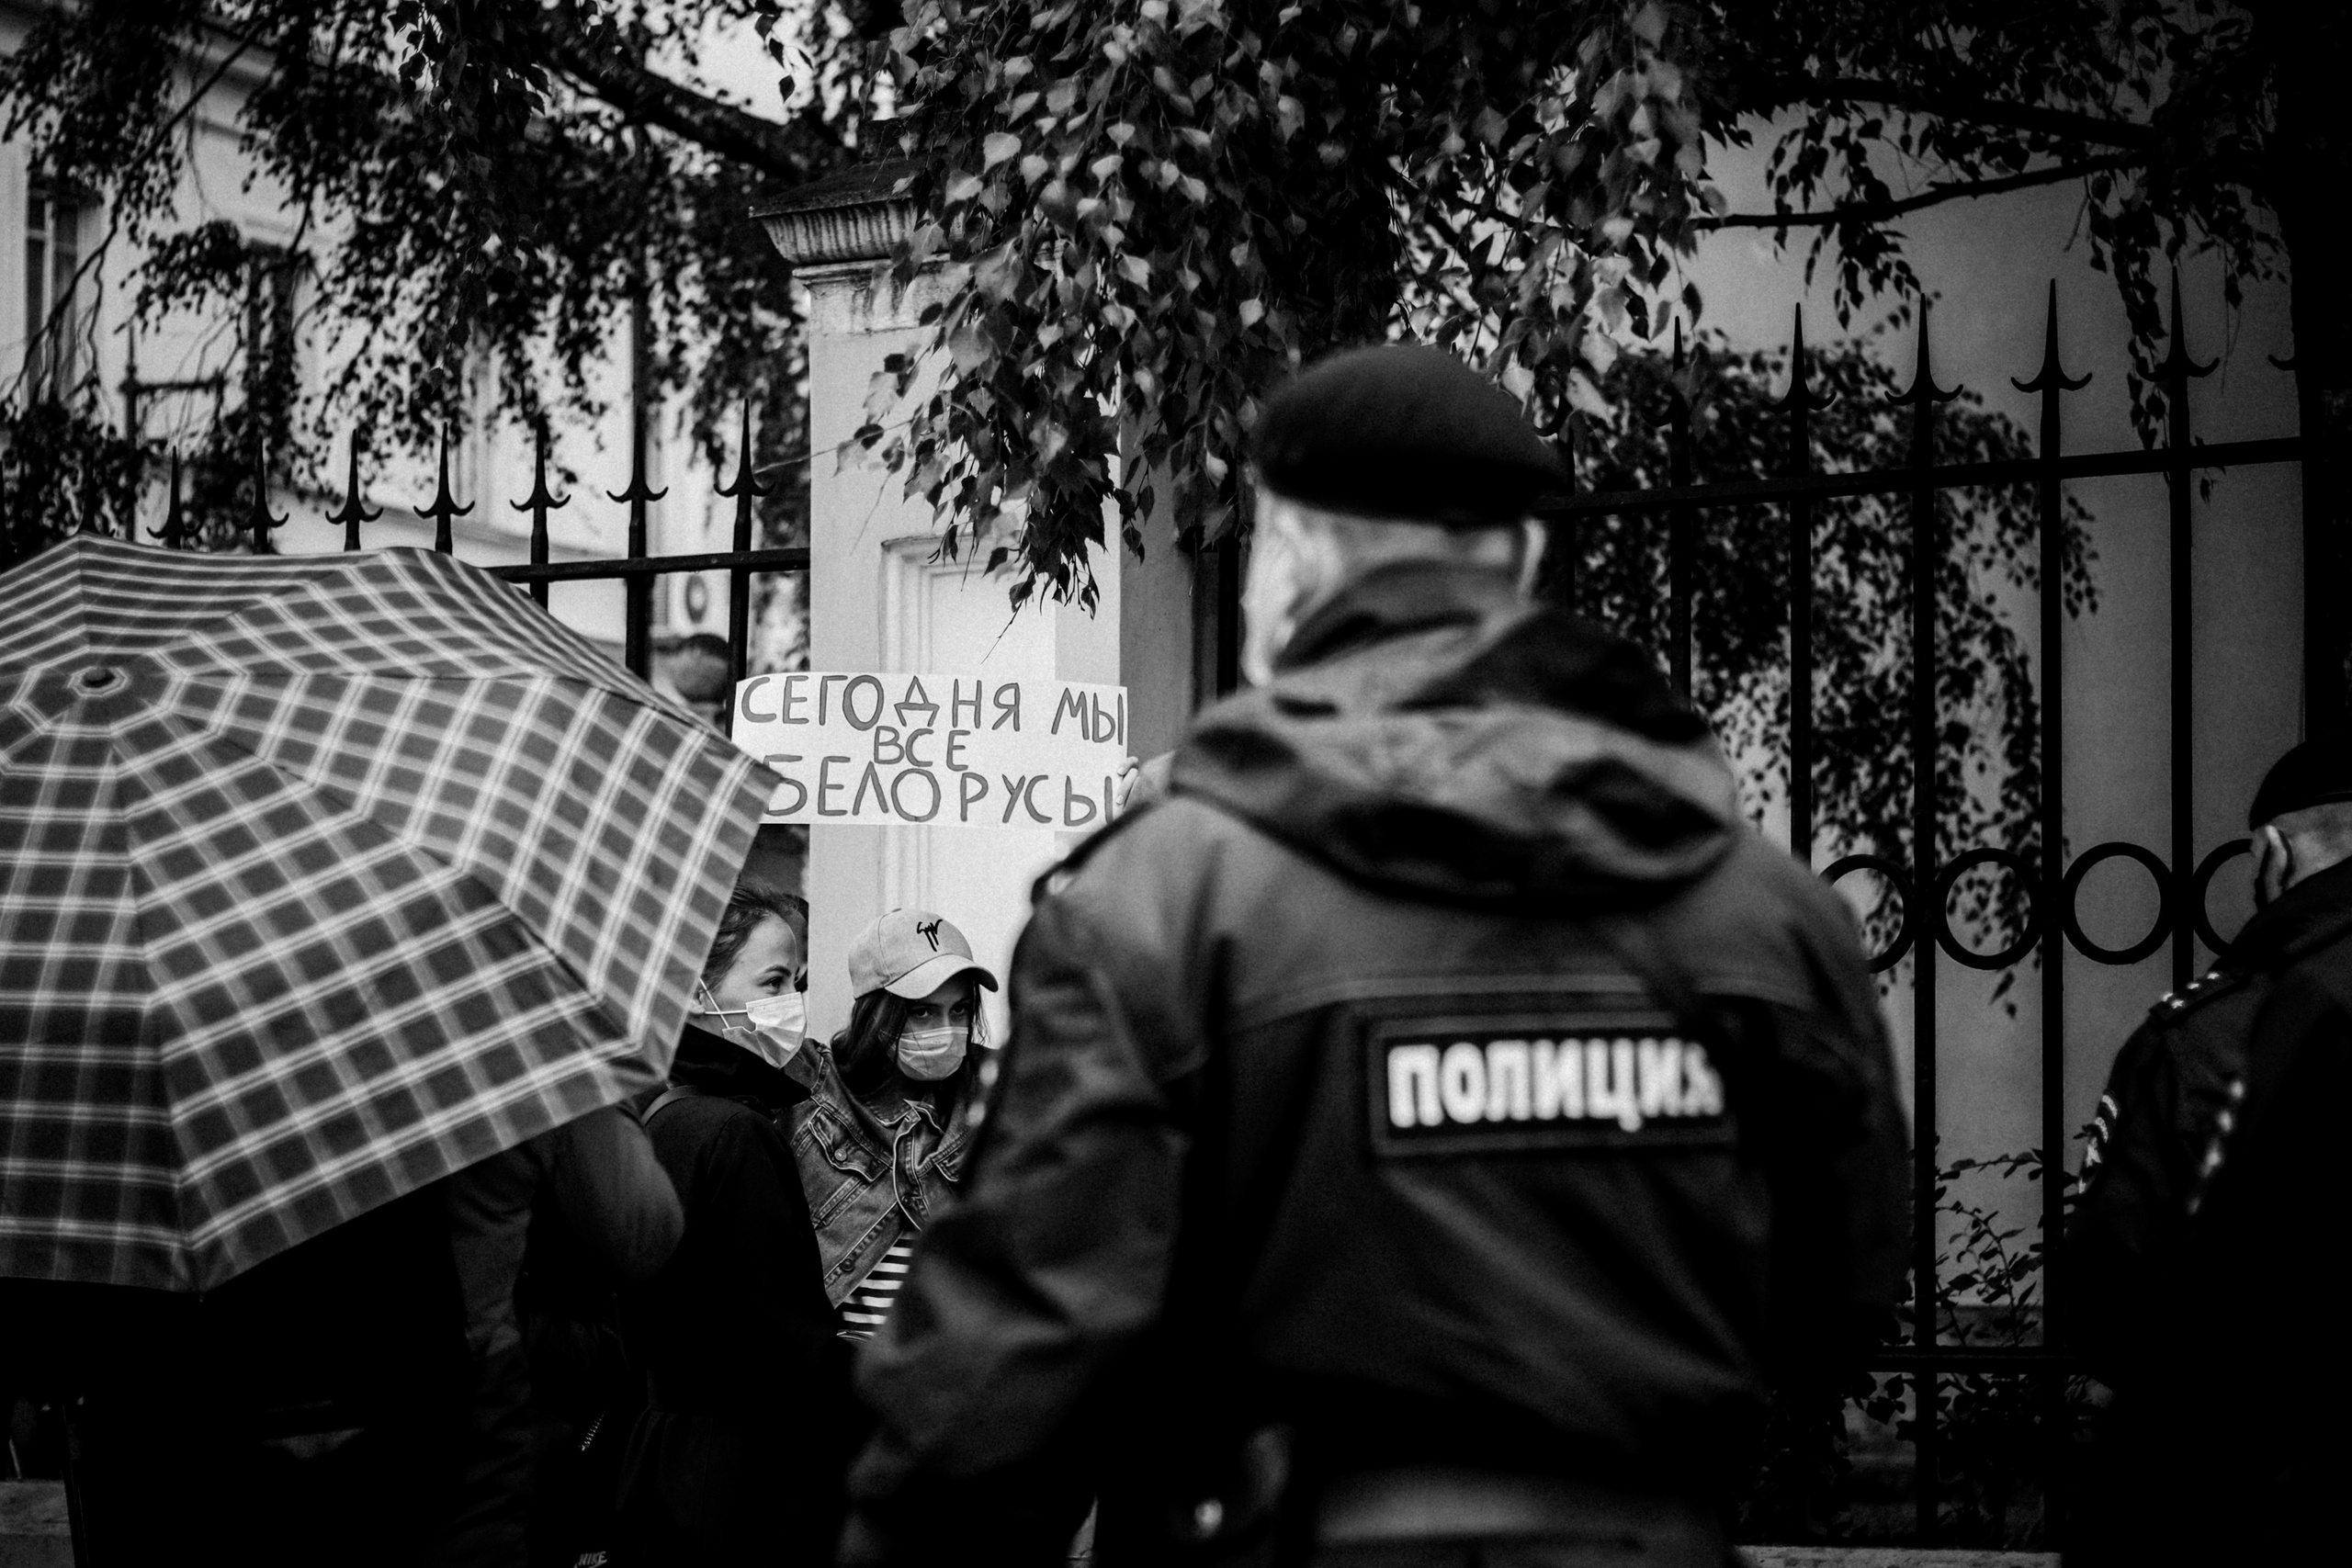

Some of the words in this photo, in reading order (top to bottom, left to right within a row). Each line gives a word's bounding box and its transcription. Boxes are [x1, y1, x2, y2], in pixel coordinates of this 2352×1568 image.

[741, 674, 1021, 731] СЕГОДНЯ
[1051, 687, 1124, 746] МЫ
[873, 726, 971, 772] ВСЕ
[763, 753, 1114, 827] БЕЛОРУСЫ
